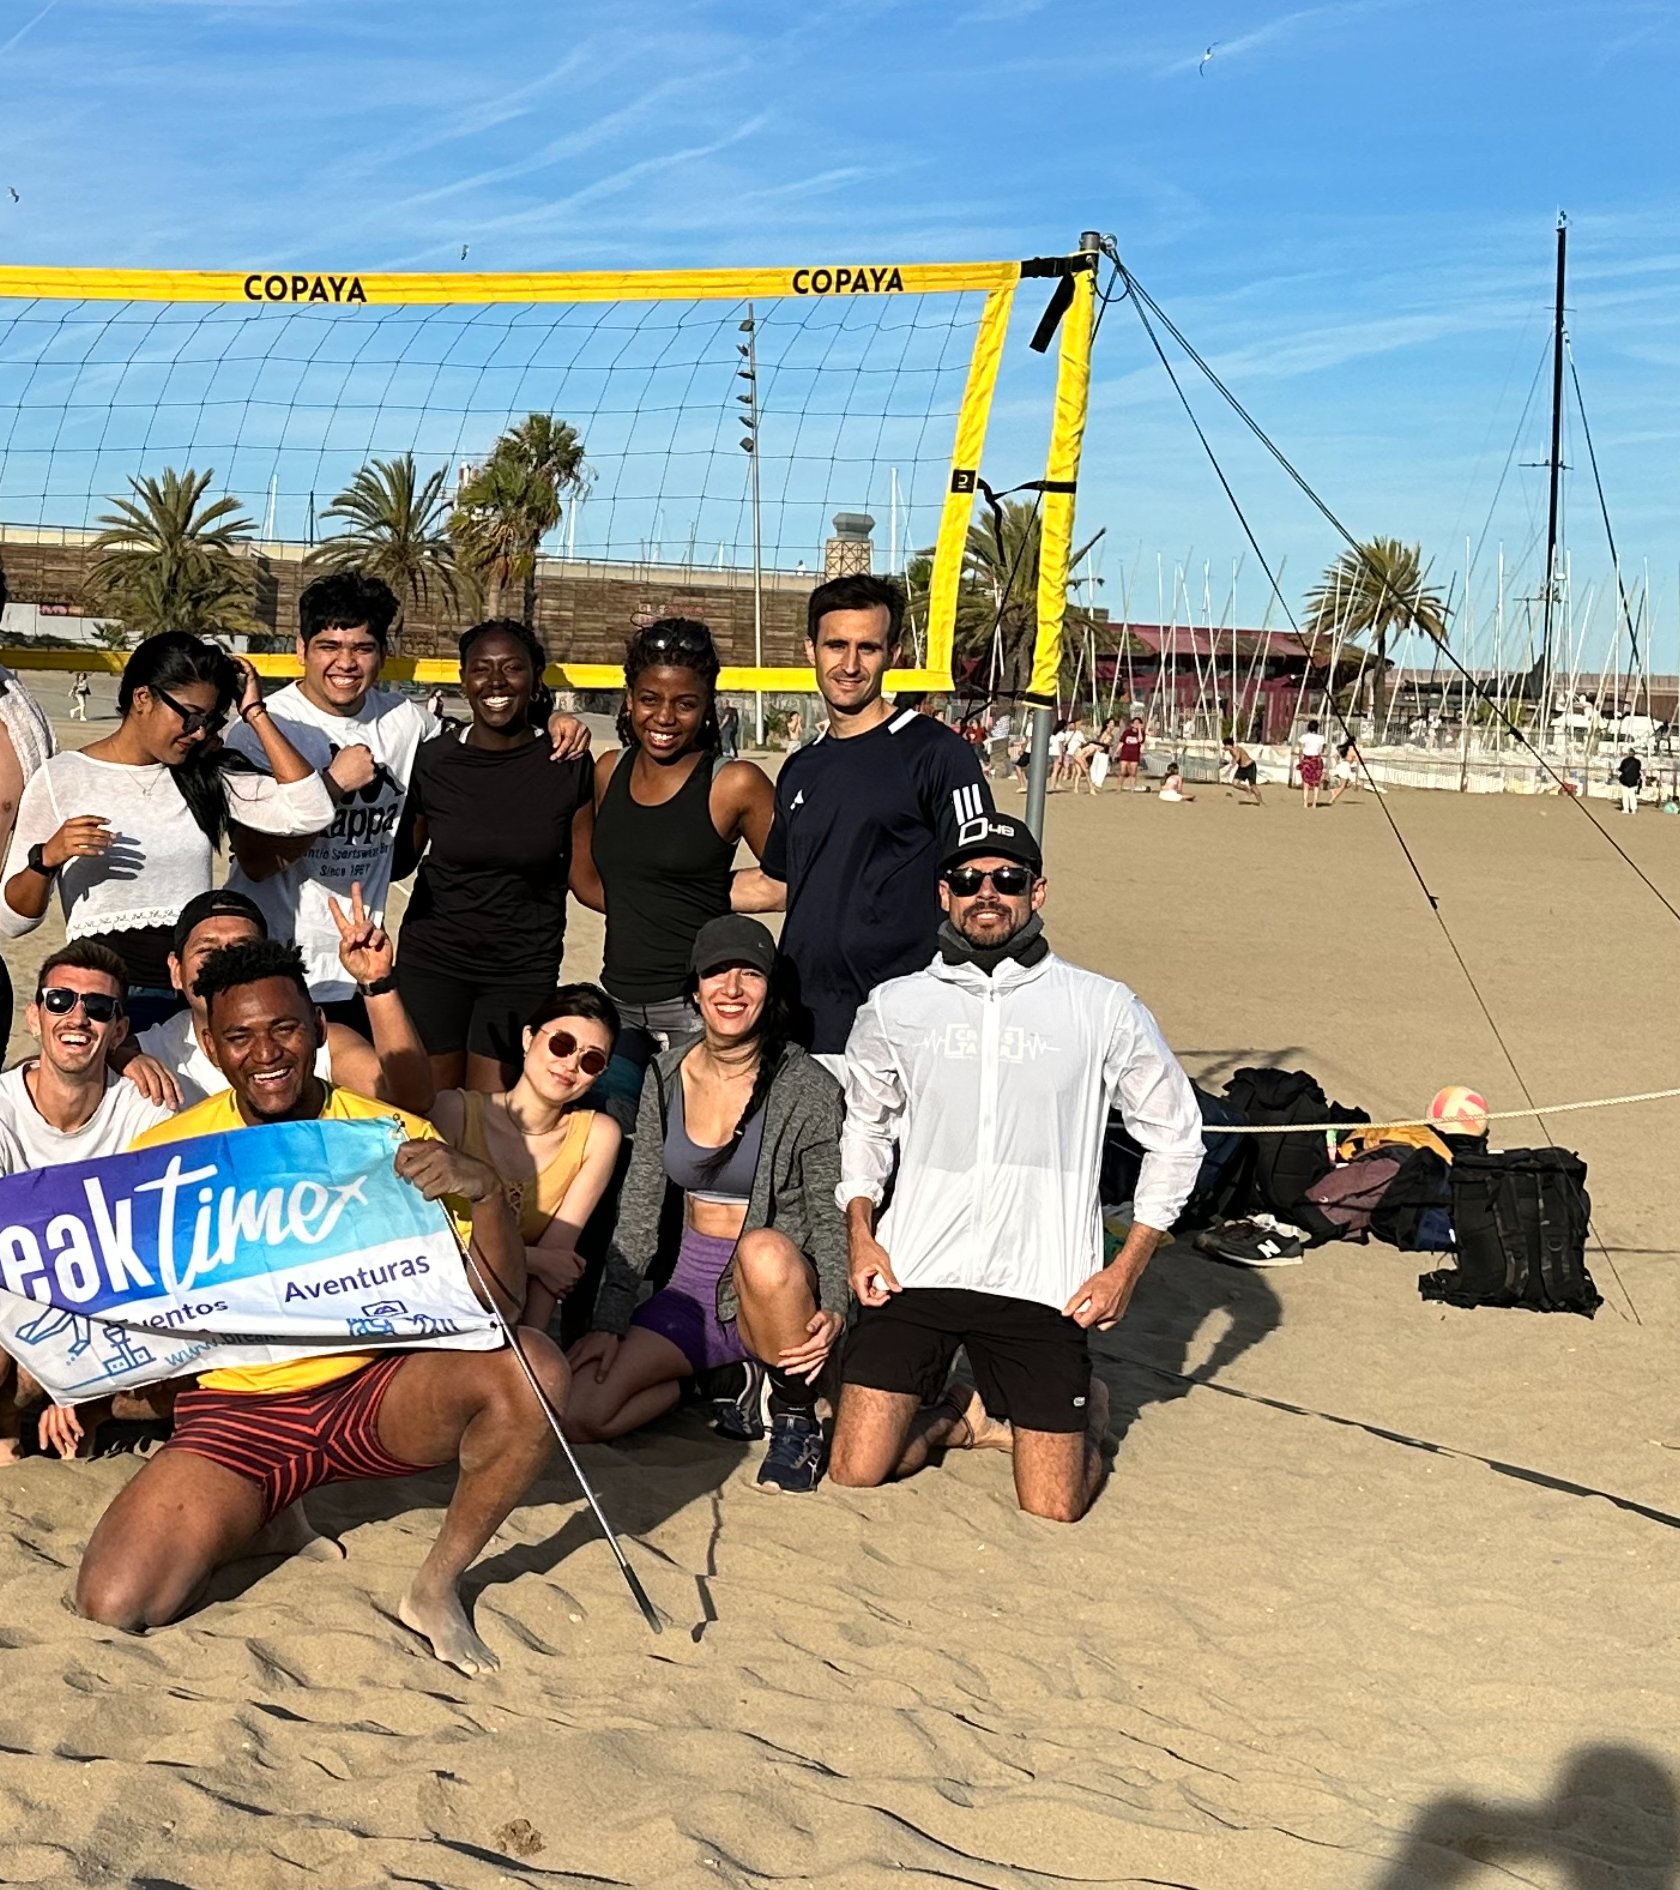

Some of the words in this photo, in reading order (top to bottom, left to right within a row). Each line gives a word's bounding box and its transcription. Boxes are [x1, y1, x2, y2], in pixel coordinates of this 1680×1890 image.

[244, 274, 368, 303] COPAYA
[792, 267, 904, 294] COPAYA
[284, 1254, 431, 1303] Aventuras
